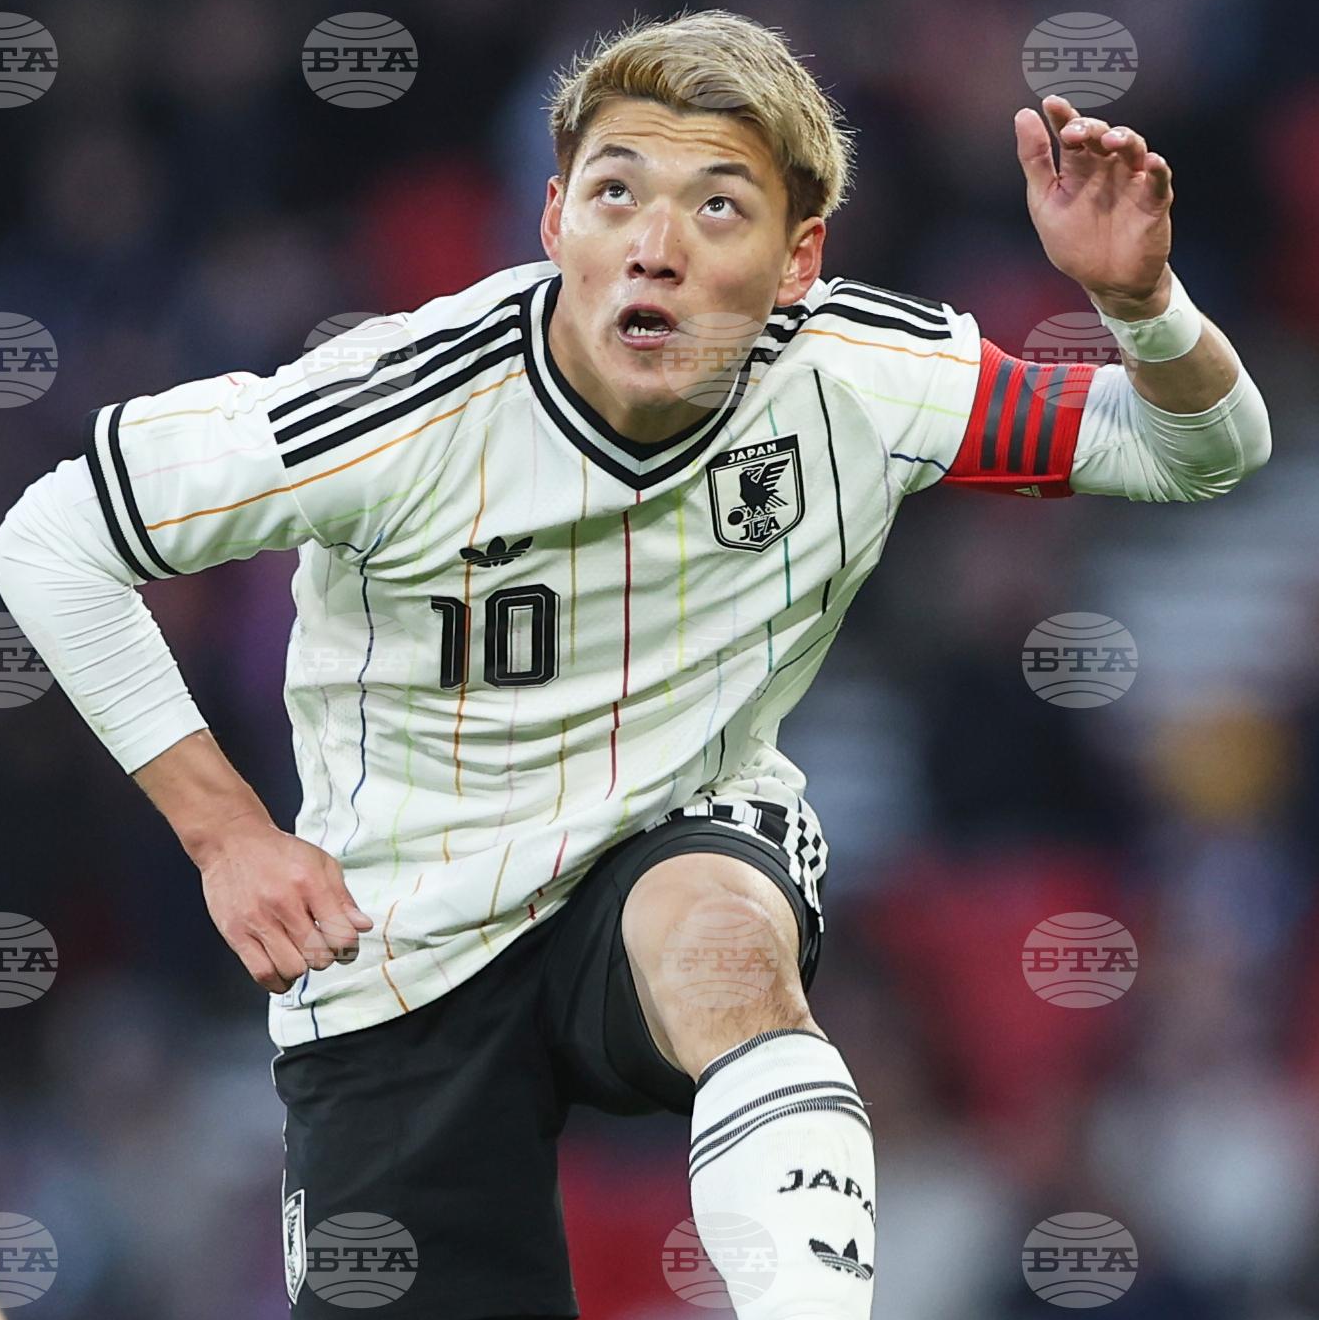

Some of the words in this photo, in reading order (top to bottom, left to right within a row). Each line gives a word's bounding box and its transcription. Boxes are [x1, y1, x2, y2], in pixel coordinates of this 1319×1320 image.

[727, 442, 777, 464] JAPAN
[739, 515, 781, 542] JFA
[430, 583, 561, 690] 10
